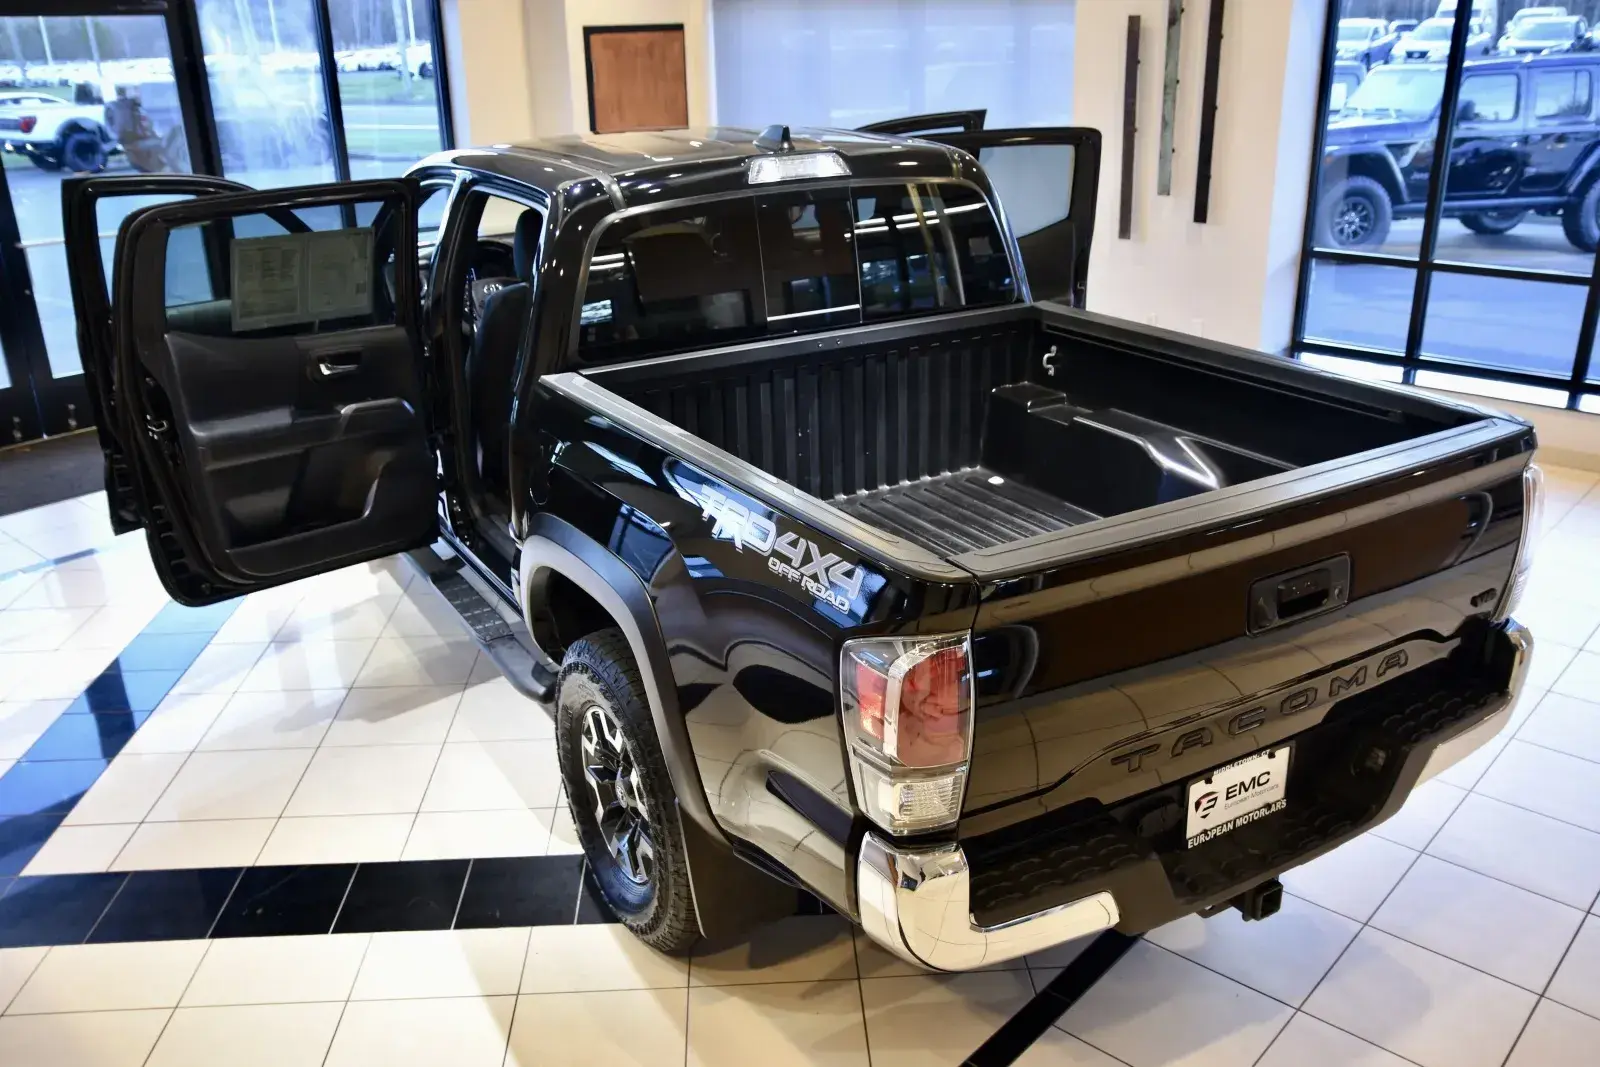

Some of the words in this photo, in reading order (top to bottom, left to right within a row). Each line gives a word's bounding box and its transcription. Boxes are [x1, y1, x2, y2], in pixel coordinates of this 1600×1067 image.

[701, 484, 776, 556] TRD
[767, 556, 801, 582] OFF
[801, 577, 850, 614] ROAD
[1110, 648, 1409, 773] TACOMA
[1225, 771, 1271, 801] EMC
[1187, 820, 1234, 850] EUROPEAN
[1235, 799, 1287, 829] MOTORCARS
